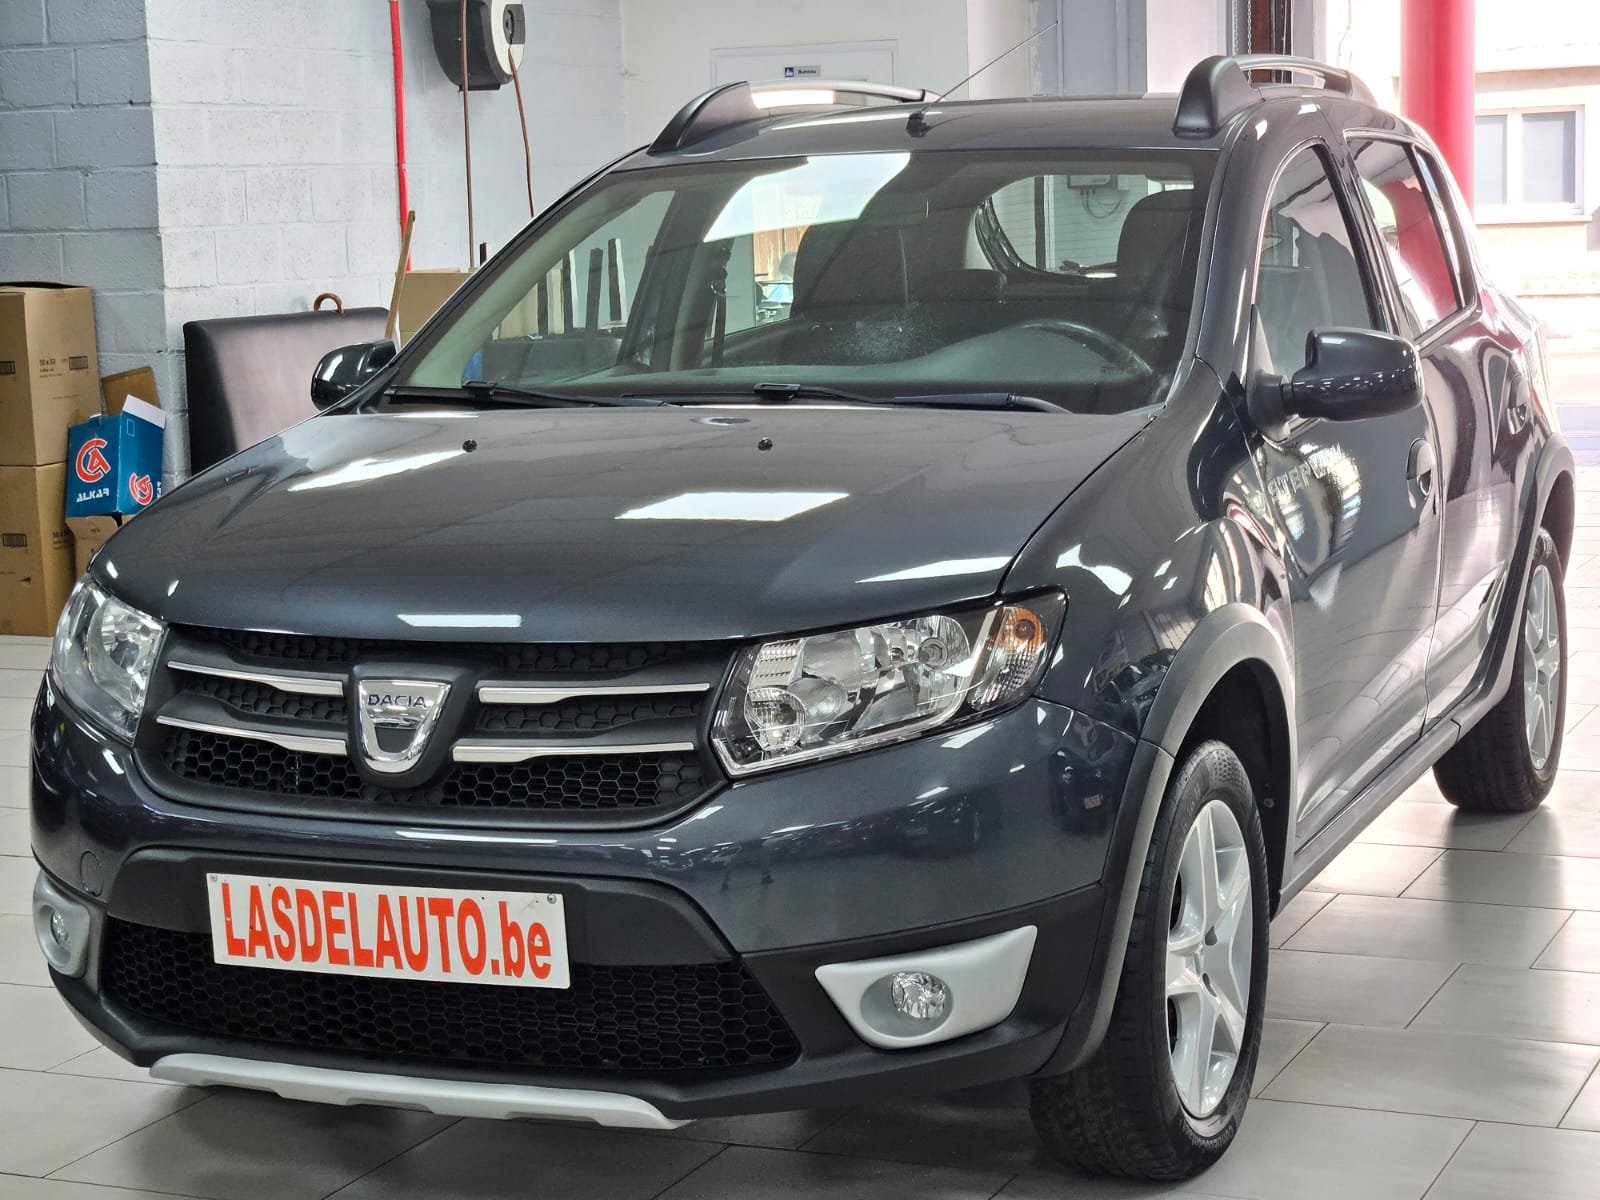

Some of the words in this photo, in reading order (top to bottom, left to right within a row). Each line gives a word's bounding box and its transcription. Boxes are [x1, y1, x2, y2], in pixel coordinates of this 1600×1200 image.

[76, 488, 110, 503] ALKAR
[367, 694, 427, 708] DACIA
[222, 882, 552, 980] LASDELAUTO.be
